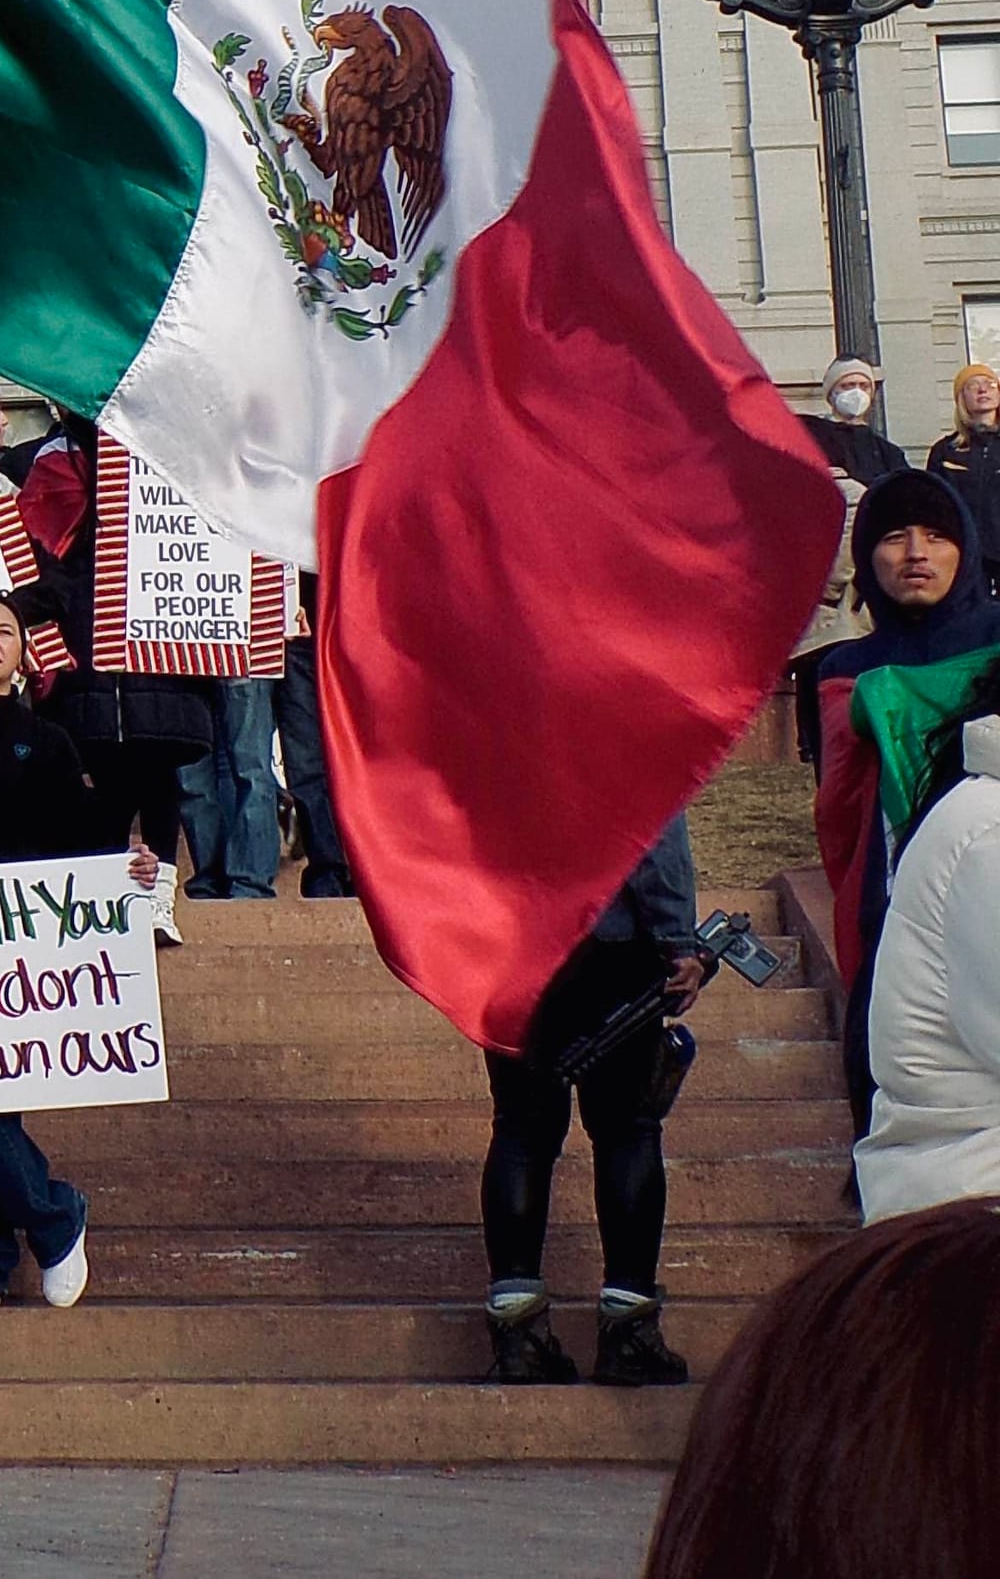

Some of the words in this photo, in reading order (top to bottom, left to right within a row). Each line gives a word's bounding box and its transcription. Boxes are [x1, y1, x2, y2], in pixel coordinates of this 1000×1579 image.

[135, 514, 197, 535] MAKE
[158, 542, 210, 562] LOVE
[140, 572, 184, 592] FOR
[196, 573, 243, 594] OUR
[154, 596, 235, 617] PEOPLE
[129, 619, 250, 641] STRONGER!
[30, 872, 151, 948] Your
[59, 1022, 161, 1079] ours
